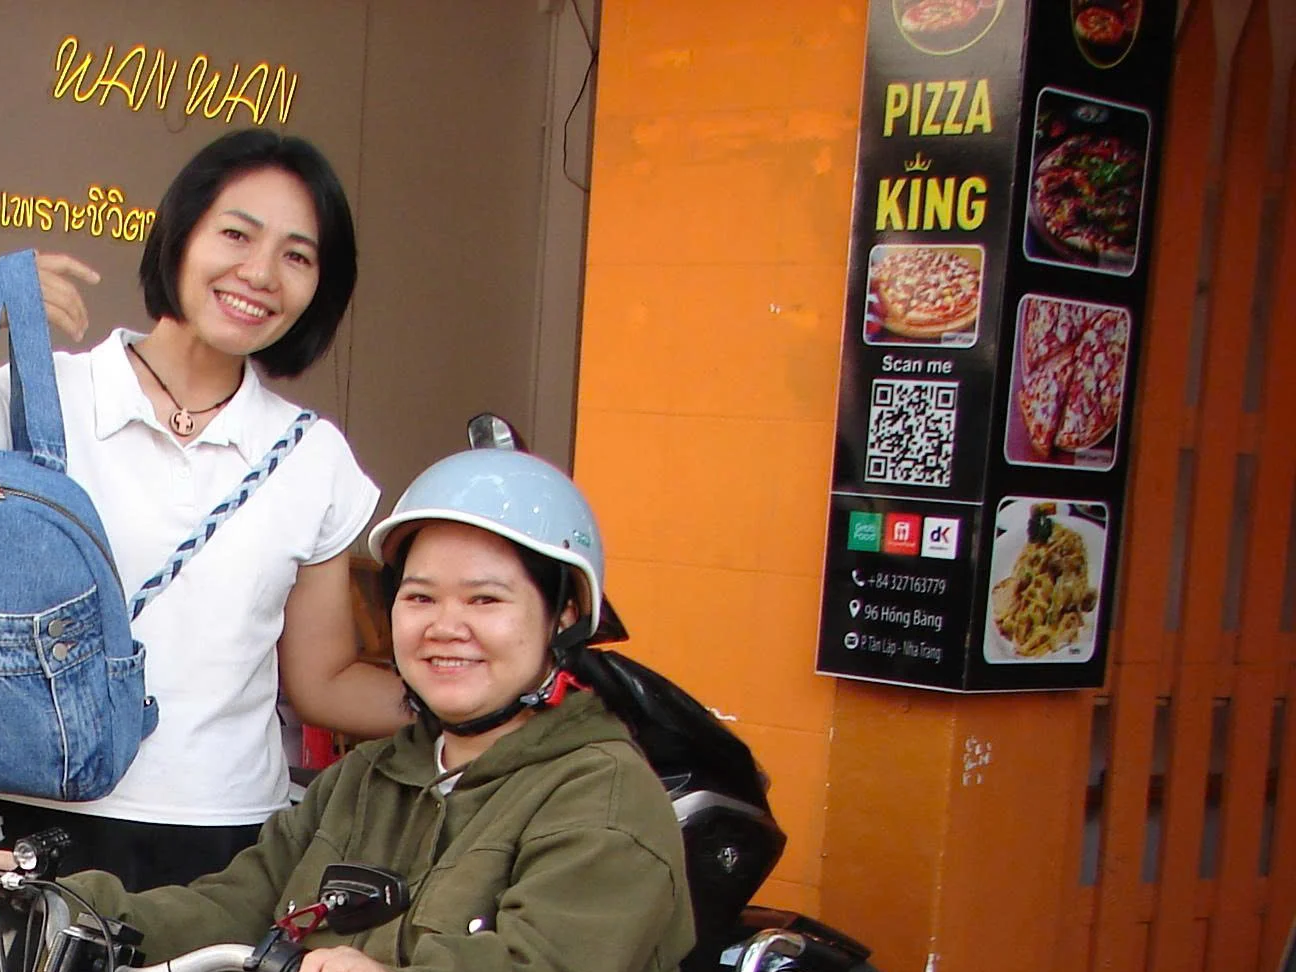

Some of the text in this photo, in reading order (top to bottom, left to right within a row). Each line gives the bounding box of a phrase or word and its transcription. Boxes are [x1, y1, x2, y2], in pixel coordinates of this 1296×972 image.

[54, 36, 298, 125] WAN WAN
[882, 79, 993, 137] PIZZA
[875, 175, 987, 232] KING
[881, 355, 952, 374] Scan me
[864, 604, 879, 620] 96
